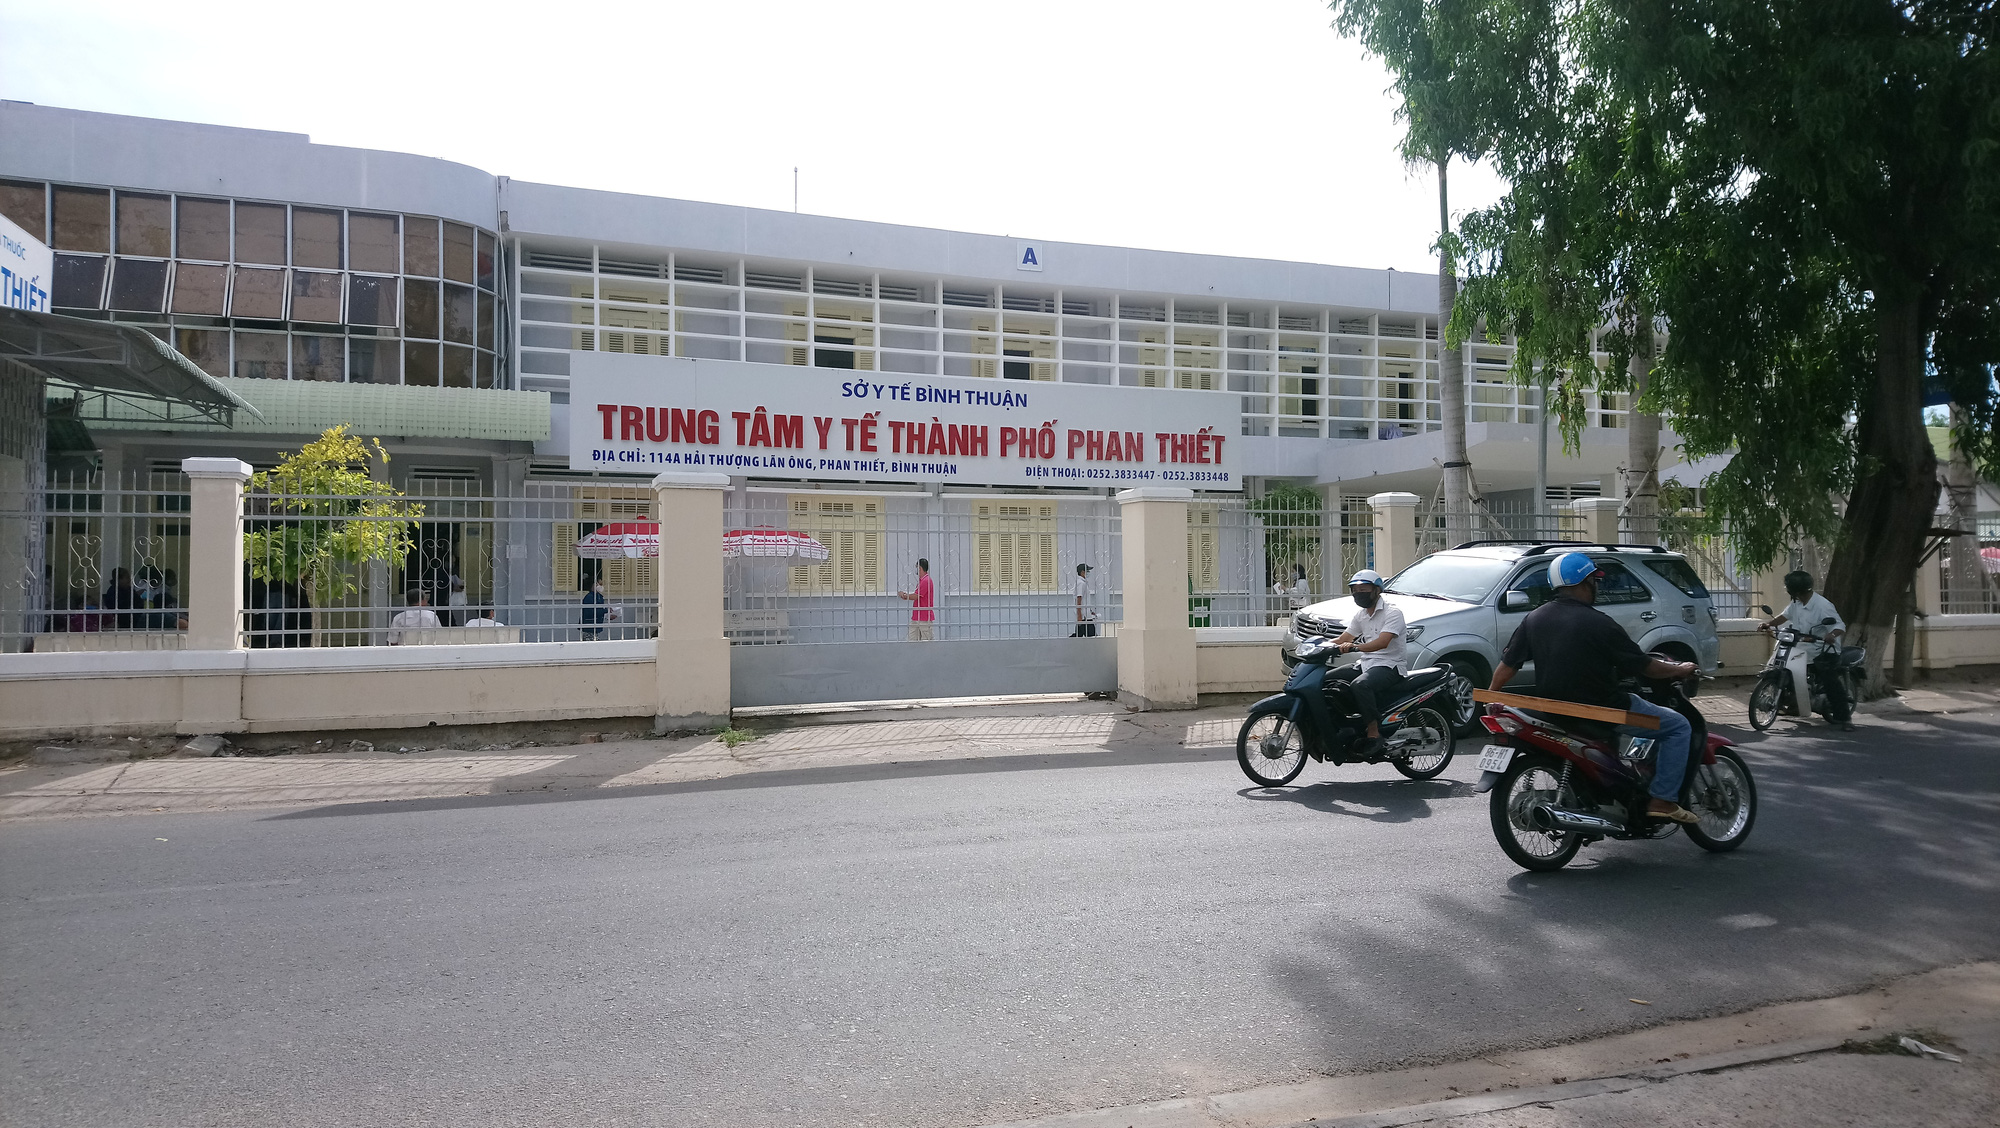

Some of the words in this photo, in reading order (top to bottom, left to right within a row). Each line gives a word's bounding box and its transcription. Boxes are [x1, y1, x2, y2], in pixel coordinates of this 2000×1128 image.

[3, 234, 26, 261] THUỐC
[1022, 247, 1038, 265] A
[1, 265, 47, 312] THIẾT
[841, 378, 870, 399] SỞ
[872, 384, 885, 400] Y
[888, 381, 911, 402] TẾ
[915, 385, 961, 404] BÌNH
[964, 388, 1028, 411] THUẬN
[598, 404, 720, 446] TRUNG
[732, 406, 804, 450] TÂM
[813, 416, 833, 451] Y
[842, 411, 881, 452] TẾ
[888, 416, 988, 457] THÀNH
[1000, 419, 1058, 460] PHỐ
[1068, 429, 1144, 462] PHAN
[1155, 425, 1226, 465] THIẾT
[592, 449, 616, 466] ĐỊA
[618, 448, 646, 464] CHỈ:
[649, 452, 681, 465] 114A
[684, 449, 706, 466] HẢI
[708, 453, 760, 470] THƯỢNG
[762, 454, 785, 469] LÃN
[788, 455, 817, 471] ÔNG,
[819, 459, 851, 471] PHAN
[853, 458, 889, 475] THIẾT,
[891, 459, 919, 473] BÌNH
[922, 461, 958, 478] THUẬN
[1025, 463, 1049, 480] ĐIỆN
[1051, 467, 1086, 481] THOẠI:
[1086, 468, 1156, 481] 0252.3833447
[1162, 471, 1230, 482] 0252.3833448
